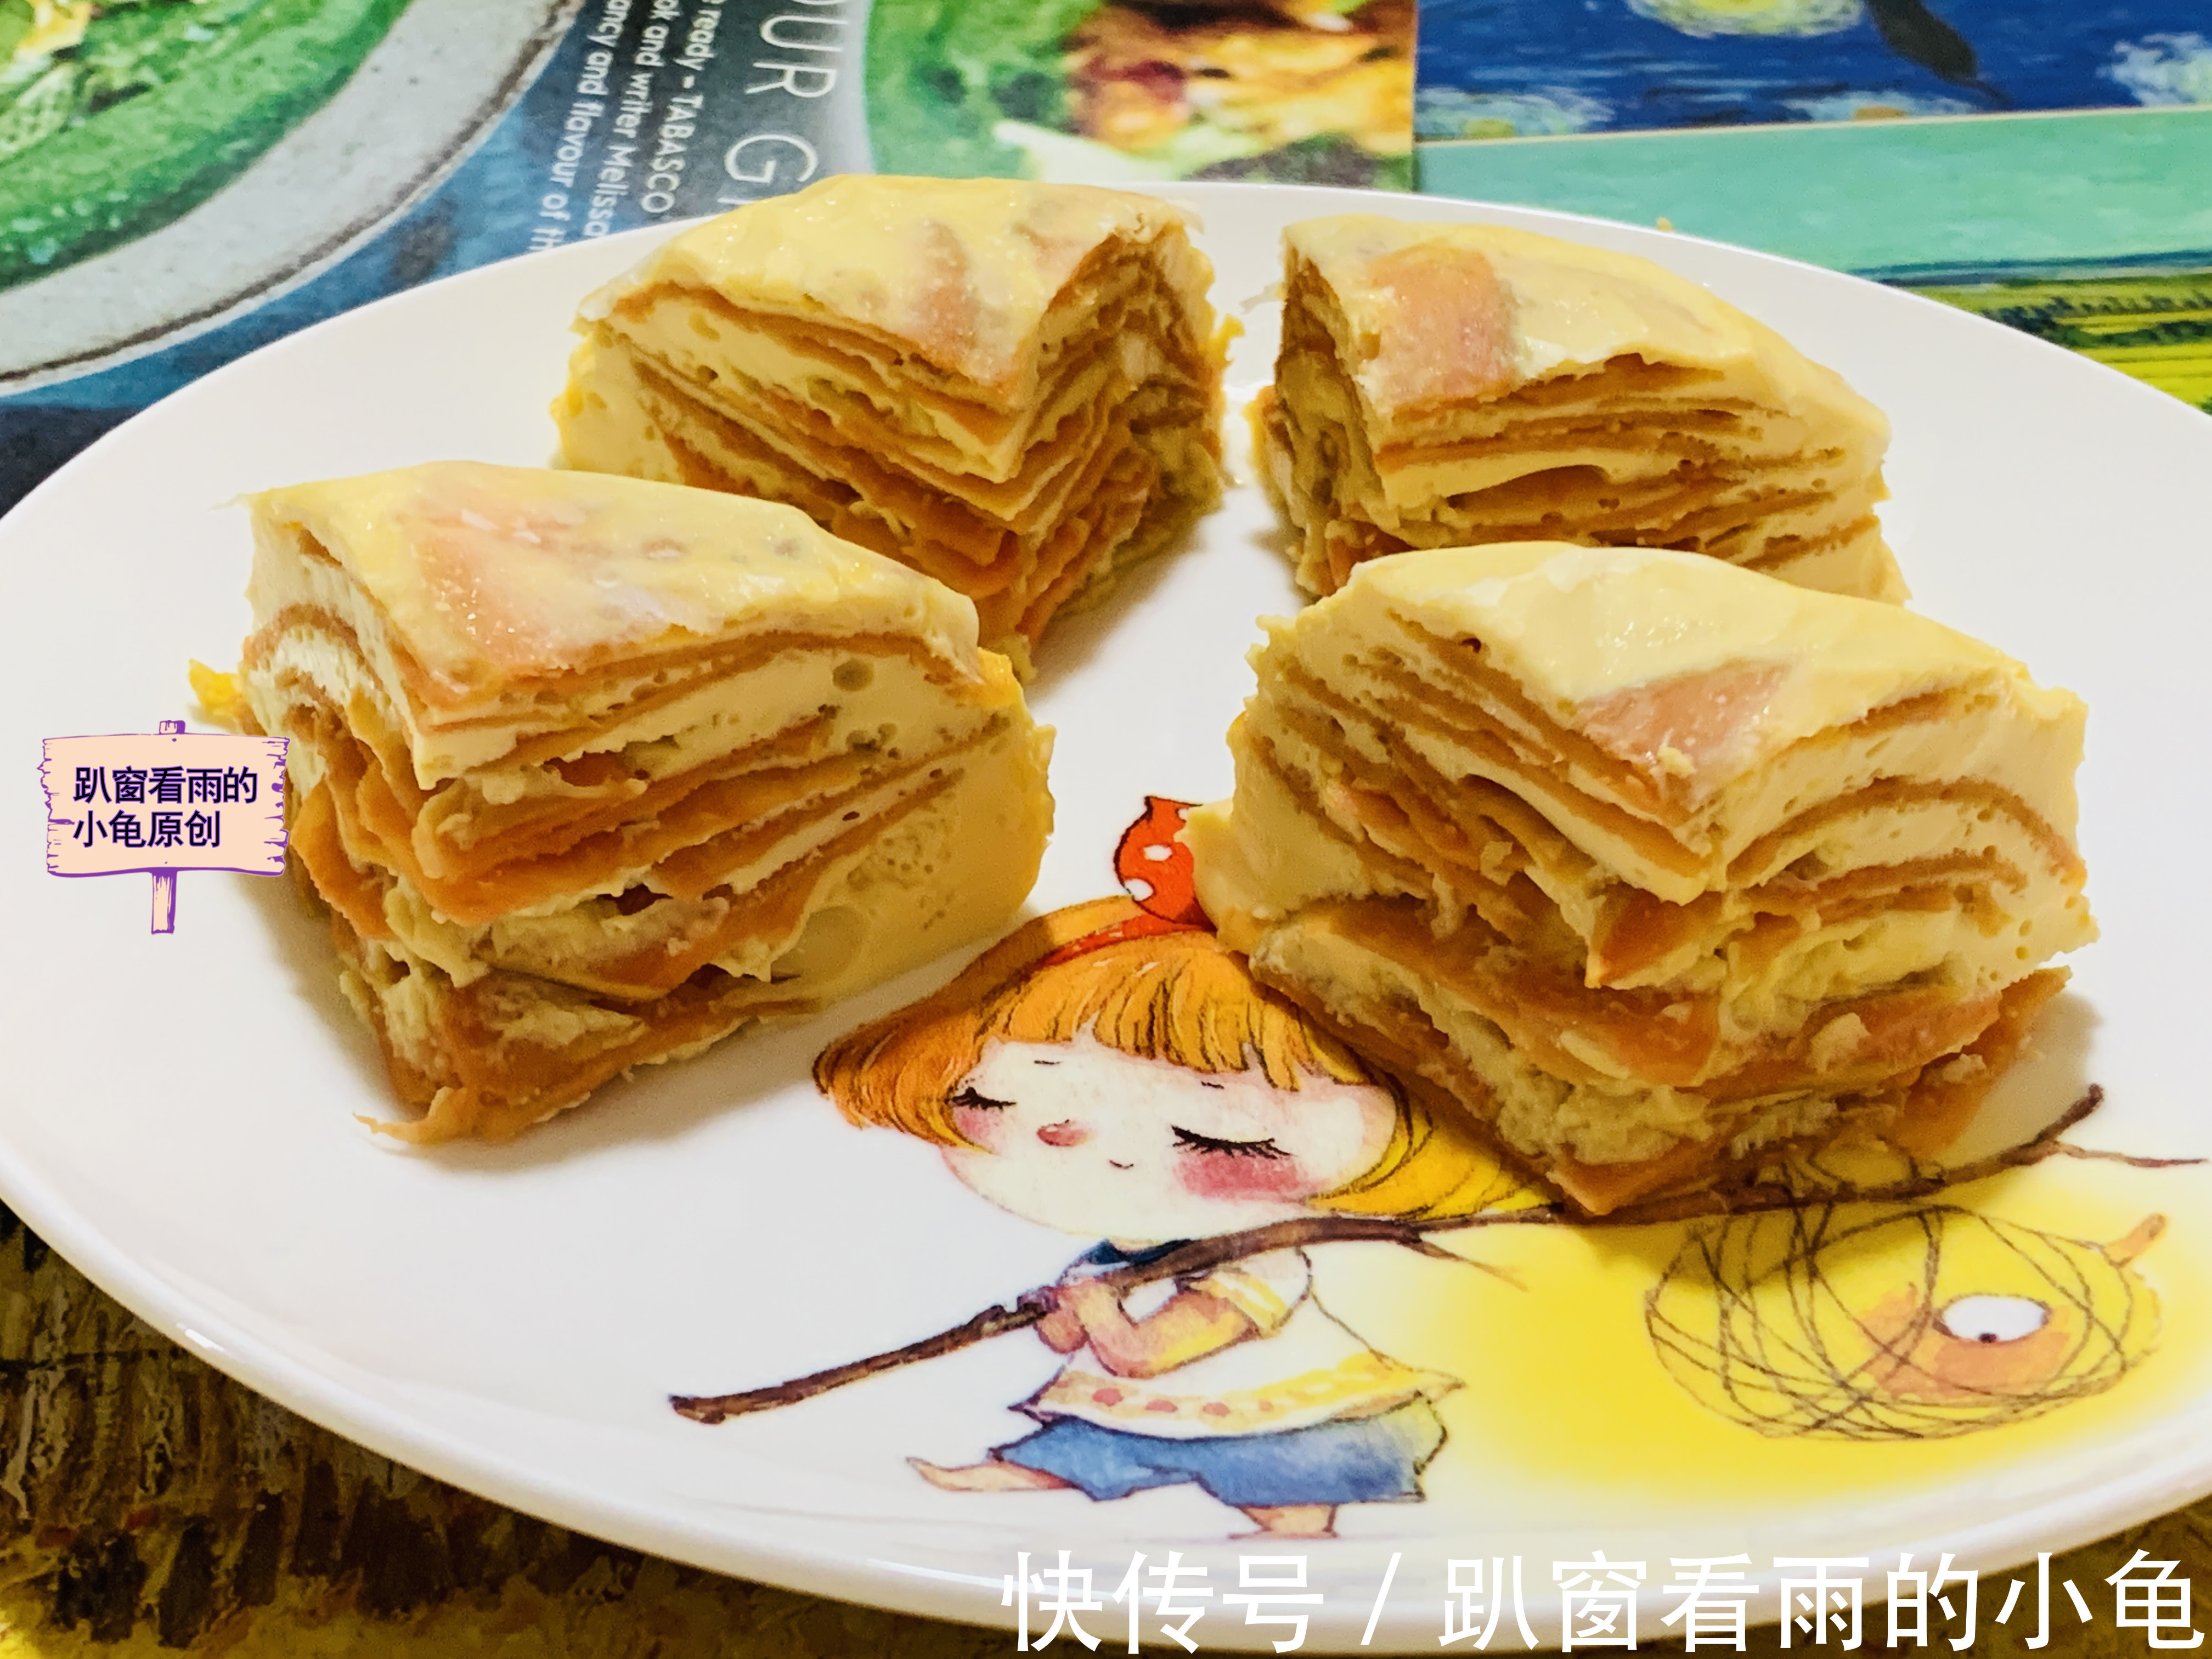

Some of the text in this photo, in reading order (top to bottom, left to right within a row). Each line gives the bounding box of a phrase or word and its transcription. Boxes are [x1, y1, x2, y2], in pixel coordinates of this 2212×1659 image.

[578, 49, 613, 95] and
[634, 24, 670, 67] and
[674, 9, 722, 71] ready
[612, 71, 654, 138] writer
[717, 0, 849, 205] UR G
[549, 101, 606, 188] flavour
[640, 94, 704, 213] TABASCO
[539, 193, 570, 221] of
[583, 144, 640, 236] Melissa
